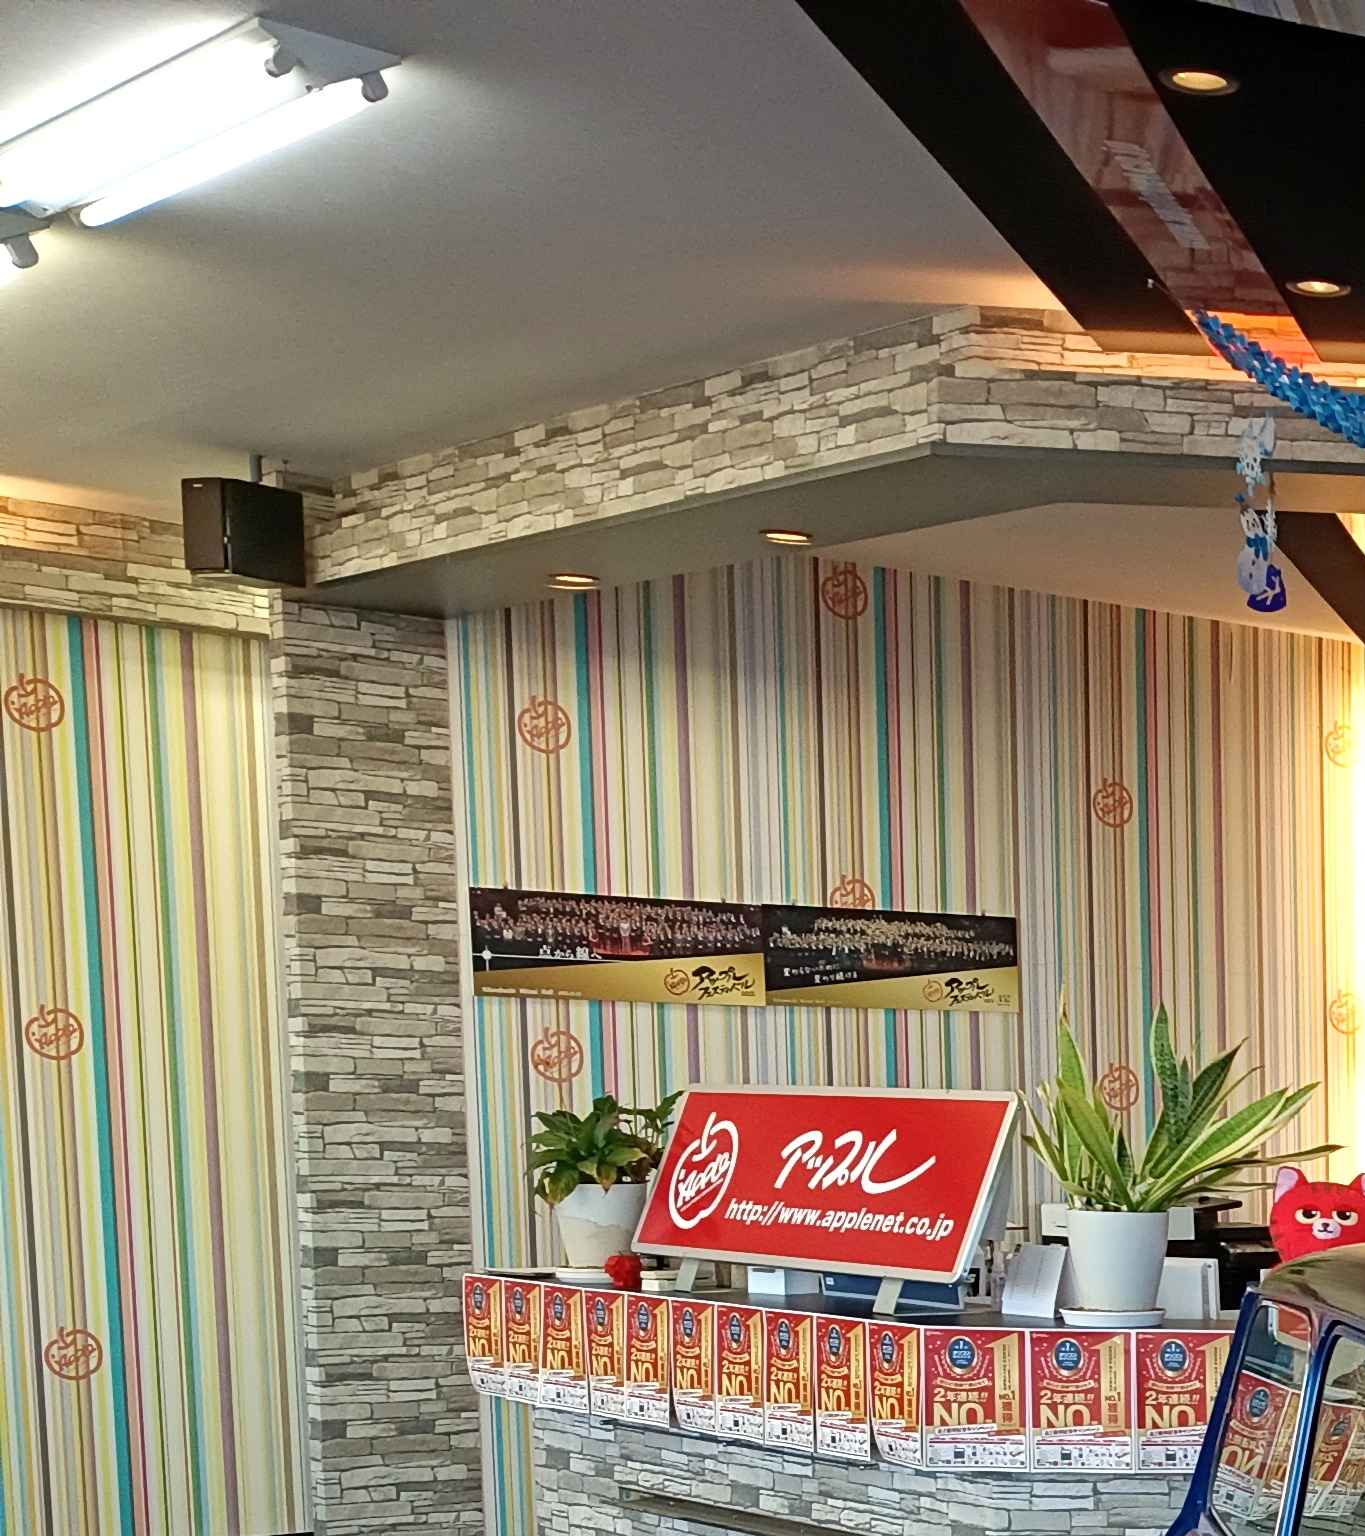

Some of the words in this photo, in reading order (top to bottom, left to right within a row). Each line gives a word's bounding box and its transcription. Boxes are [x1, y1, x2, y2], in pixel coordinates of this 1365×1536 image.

[774, 1128, 936, 1195] アップル
[725, 1198, 955, 1241] http://www.applenet.co.jp
[933, 1402, 993, 1427] NO.
[1040, 1404, 1099, 1429] NO.
[1145, 1405, 1204, 1429] NO.
